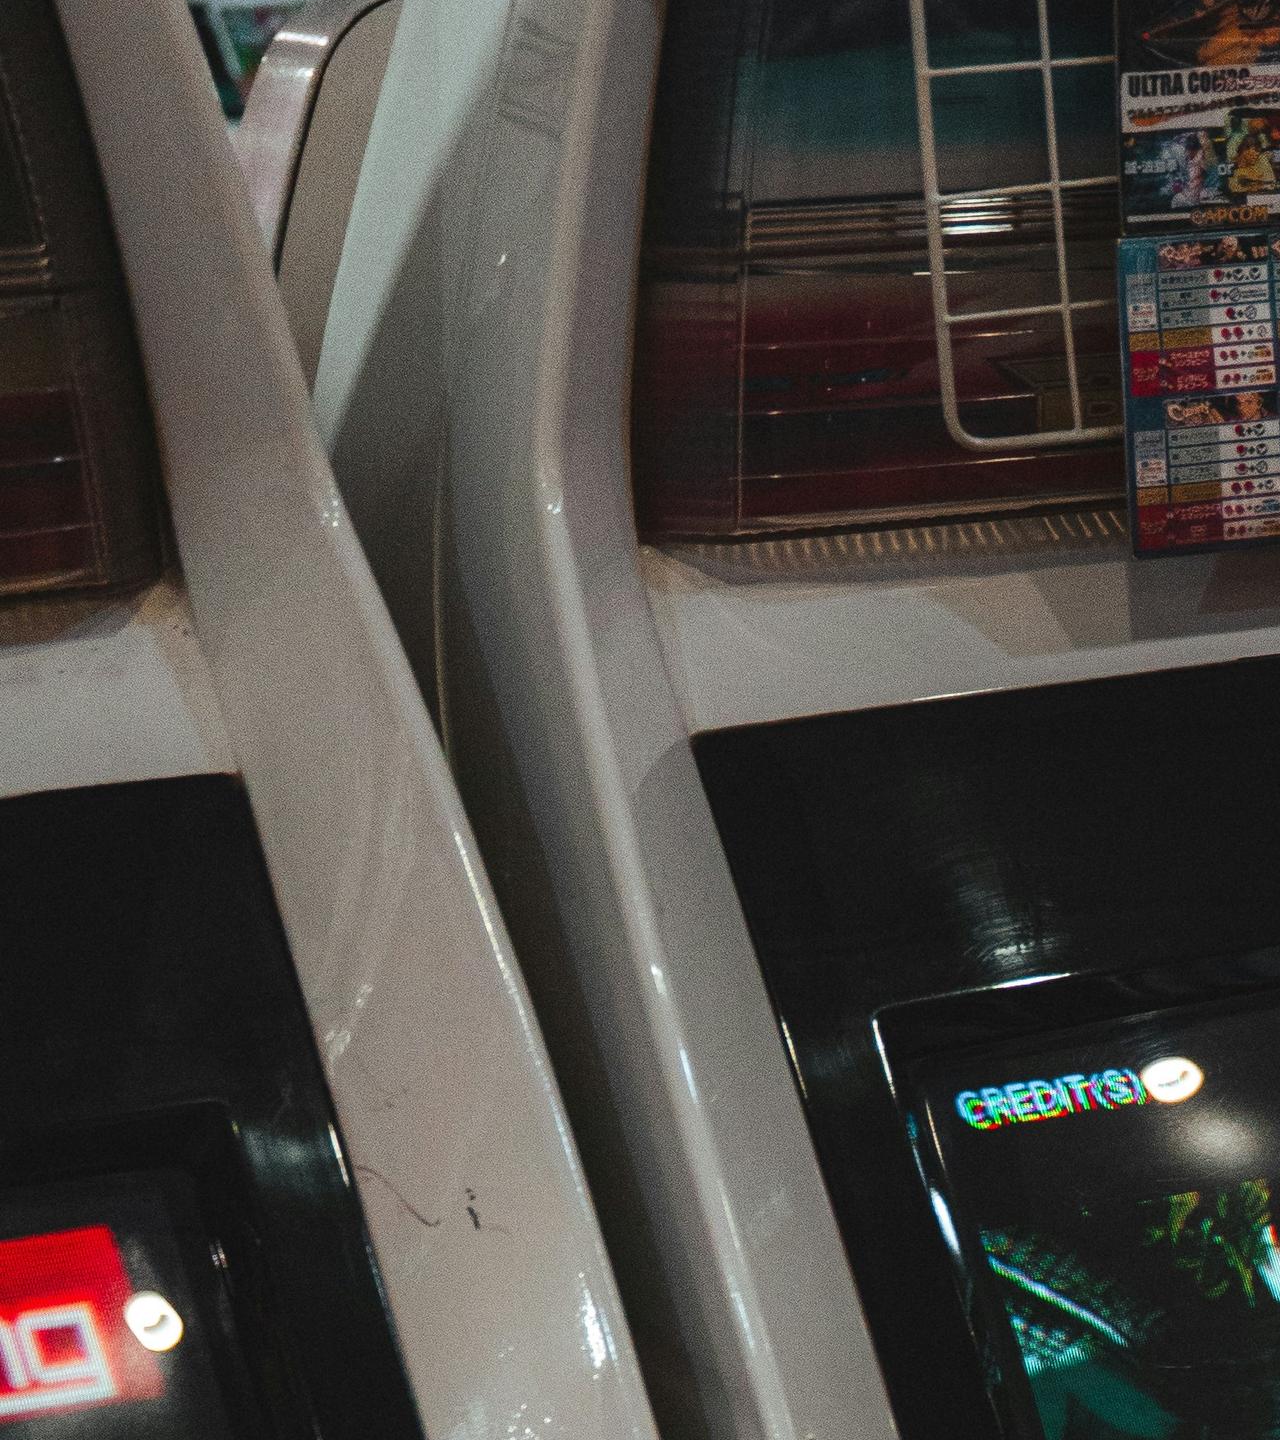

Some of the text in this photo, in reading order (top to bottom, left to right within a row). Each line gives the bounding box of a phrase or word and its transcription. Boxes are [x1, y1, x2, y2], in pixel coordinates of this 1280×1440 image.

[1128, 73, 1183, 97] ULTRA
[1190, 207, 1268, 224] CAPCOM
[955, 1068, 1149, 1129] CREDIT(S)
